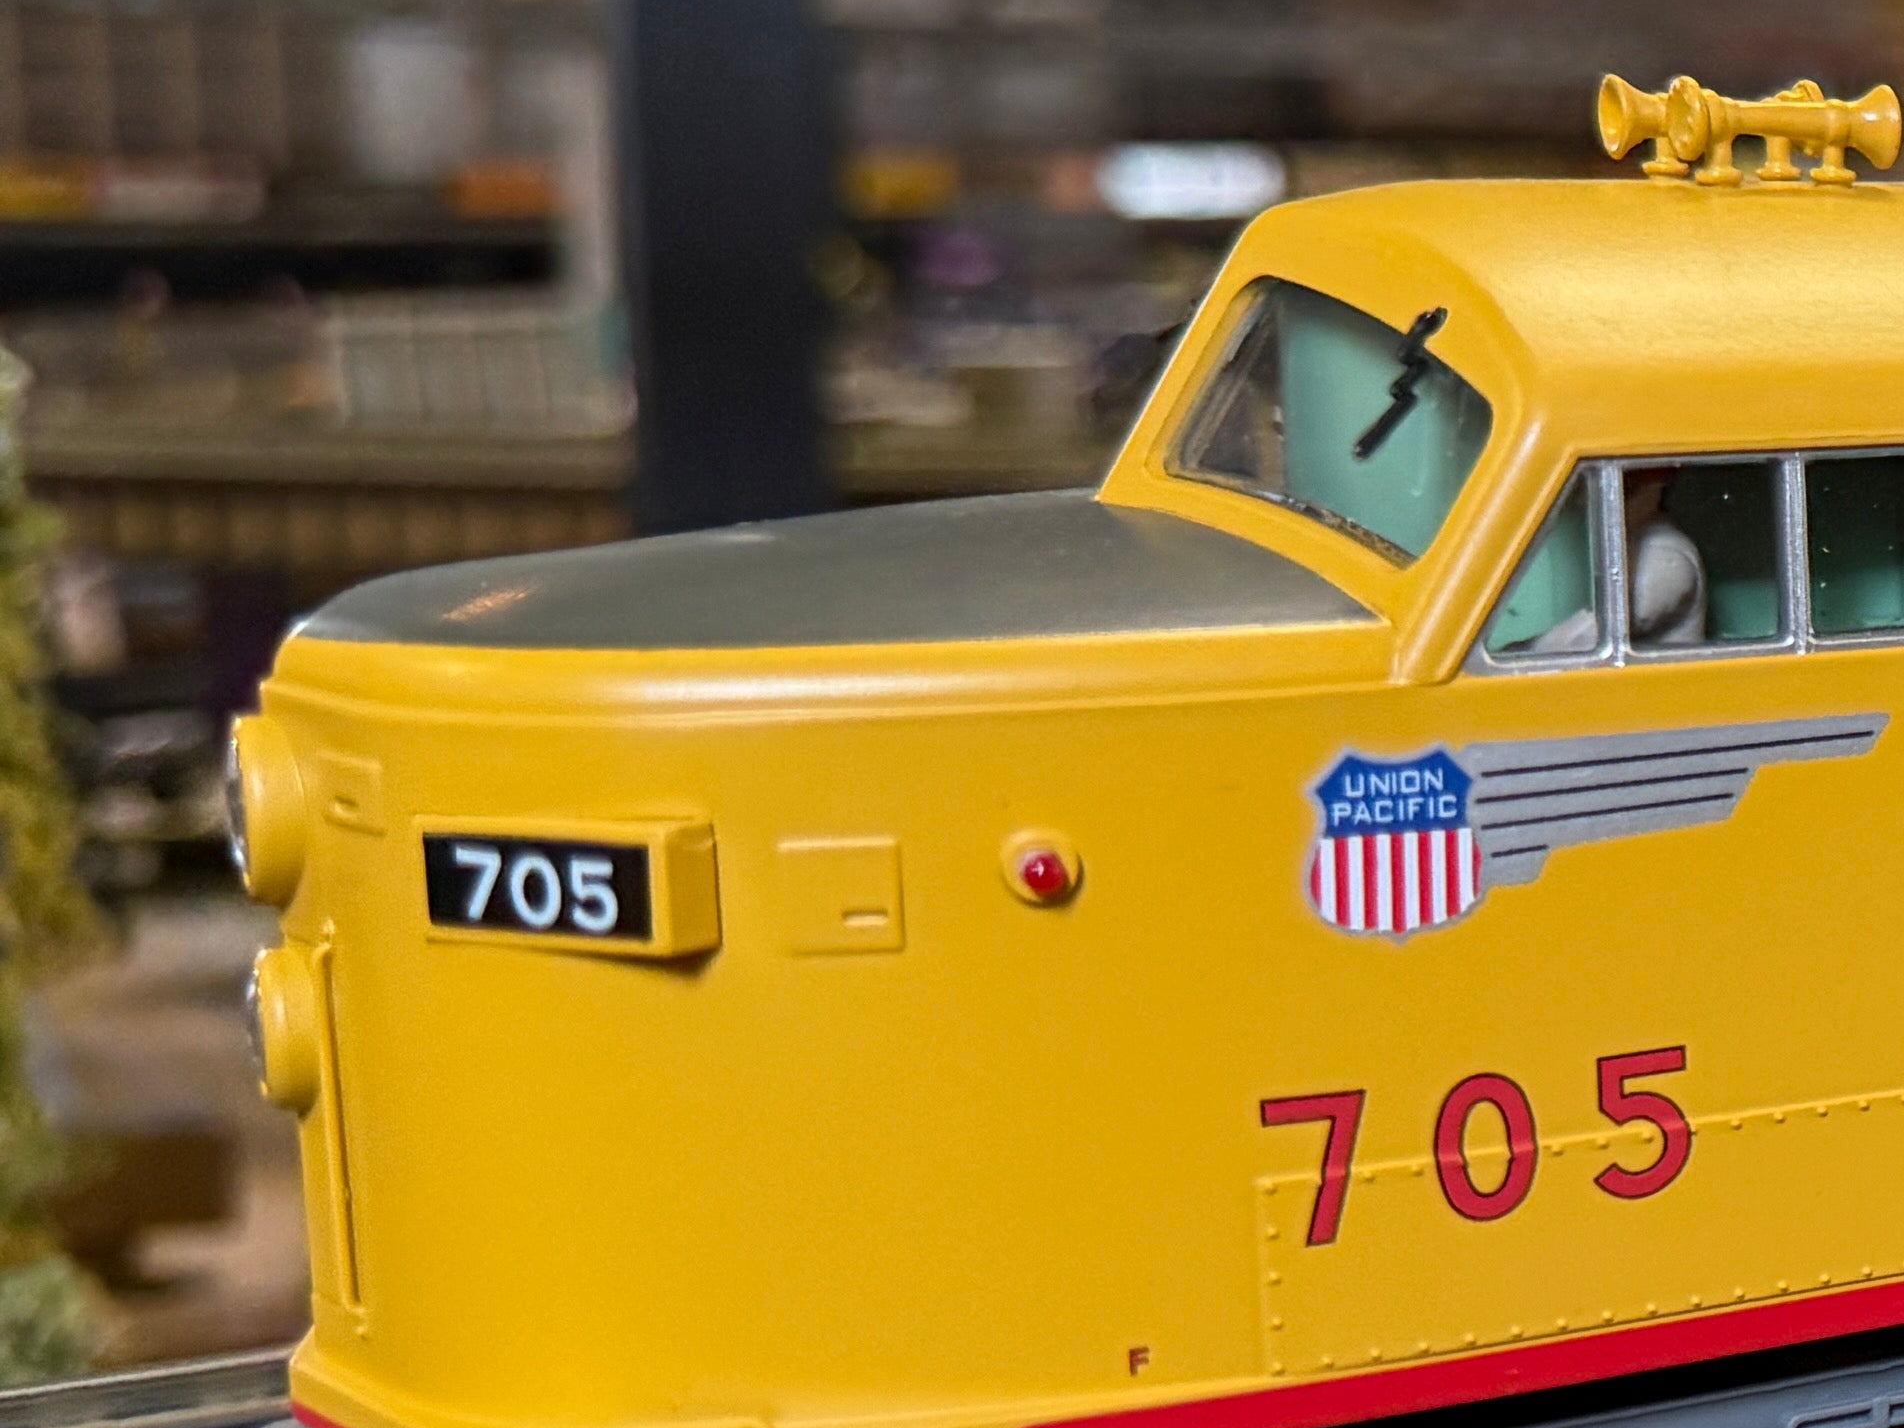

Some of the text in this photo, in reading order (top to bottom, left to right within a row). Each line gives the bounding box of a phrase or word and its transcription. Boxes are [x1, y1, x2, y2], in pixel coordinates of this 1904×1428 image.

[1344, 768, 1445, 798] UNION
[1331, 795, 1458, 827] PACIFIC
[454, 845, 619, 935] 705
[1260, 1044, 1693, 1248] 705
[1128, 1346, 1150, 1377] F
